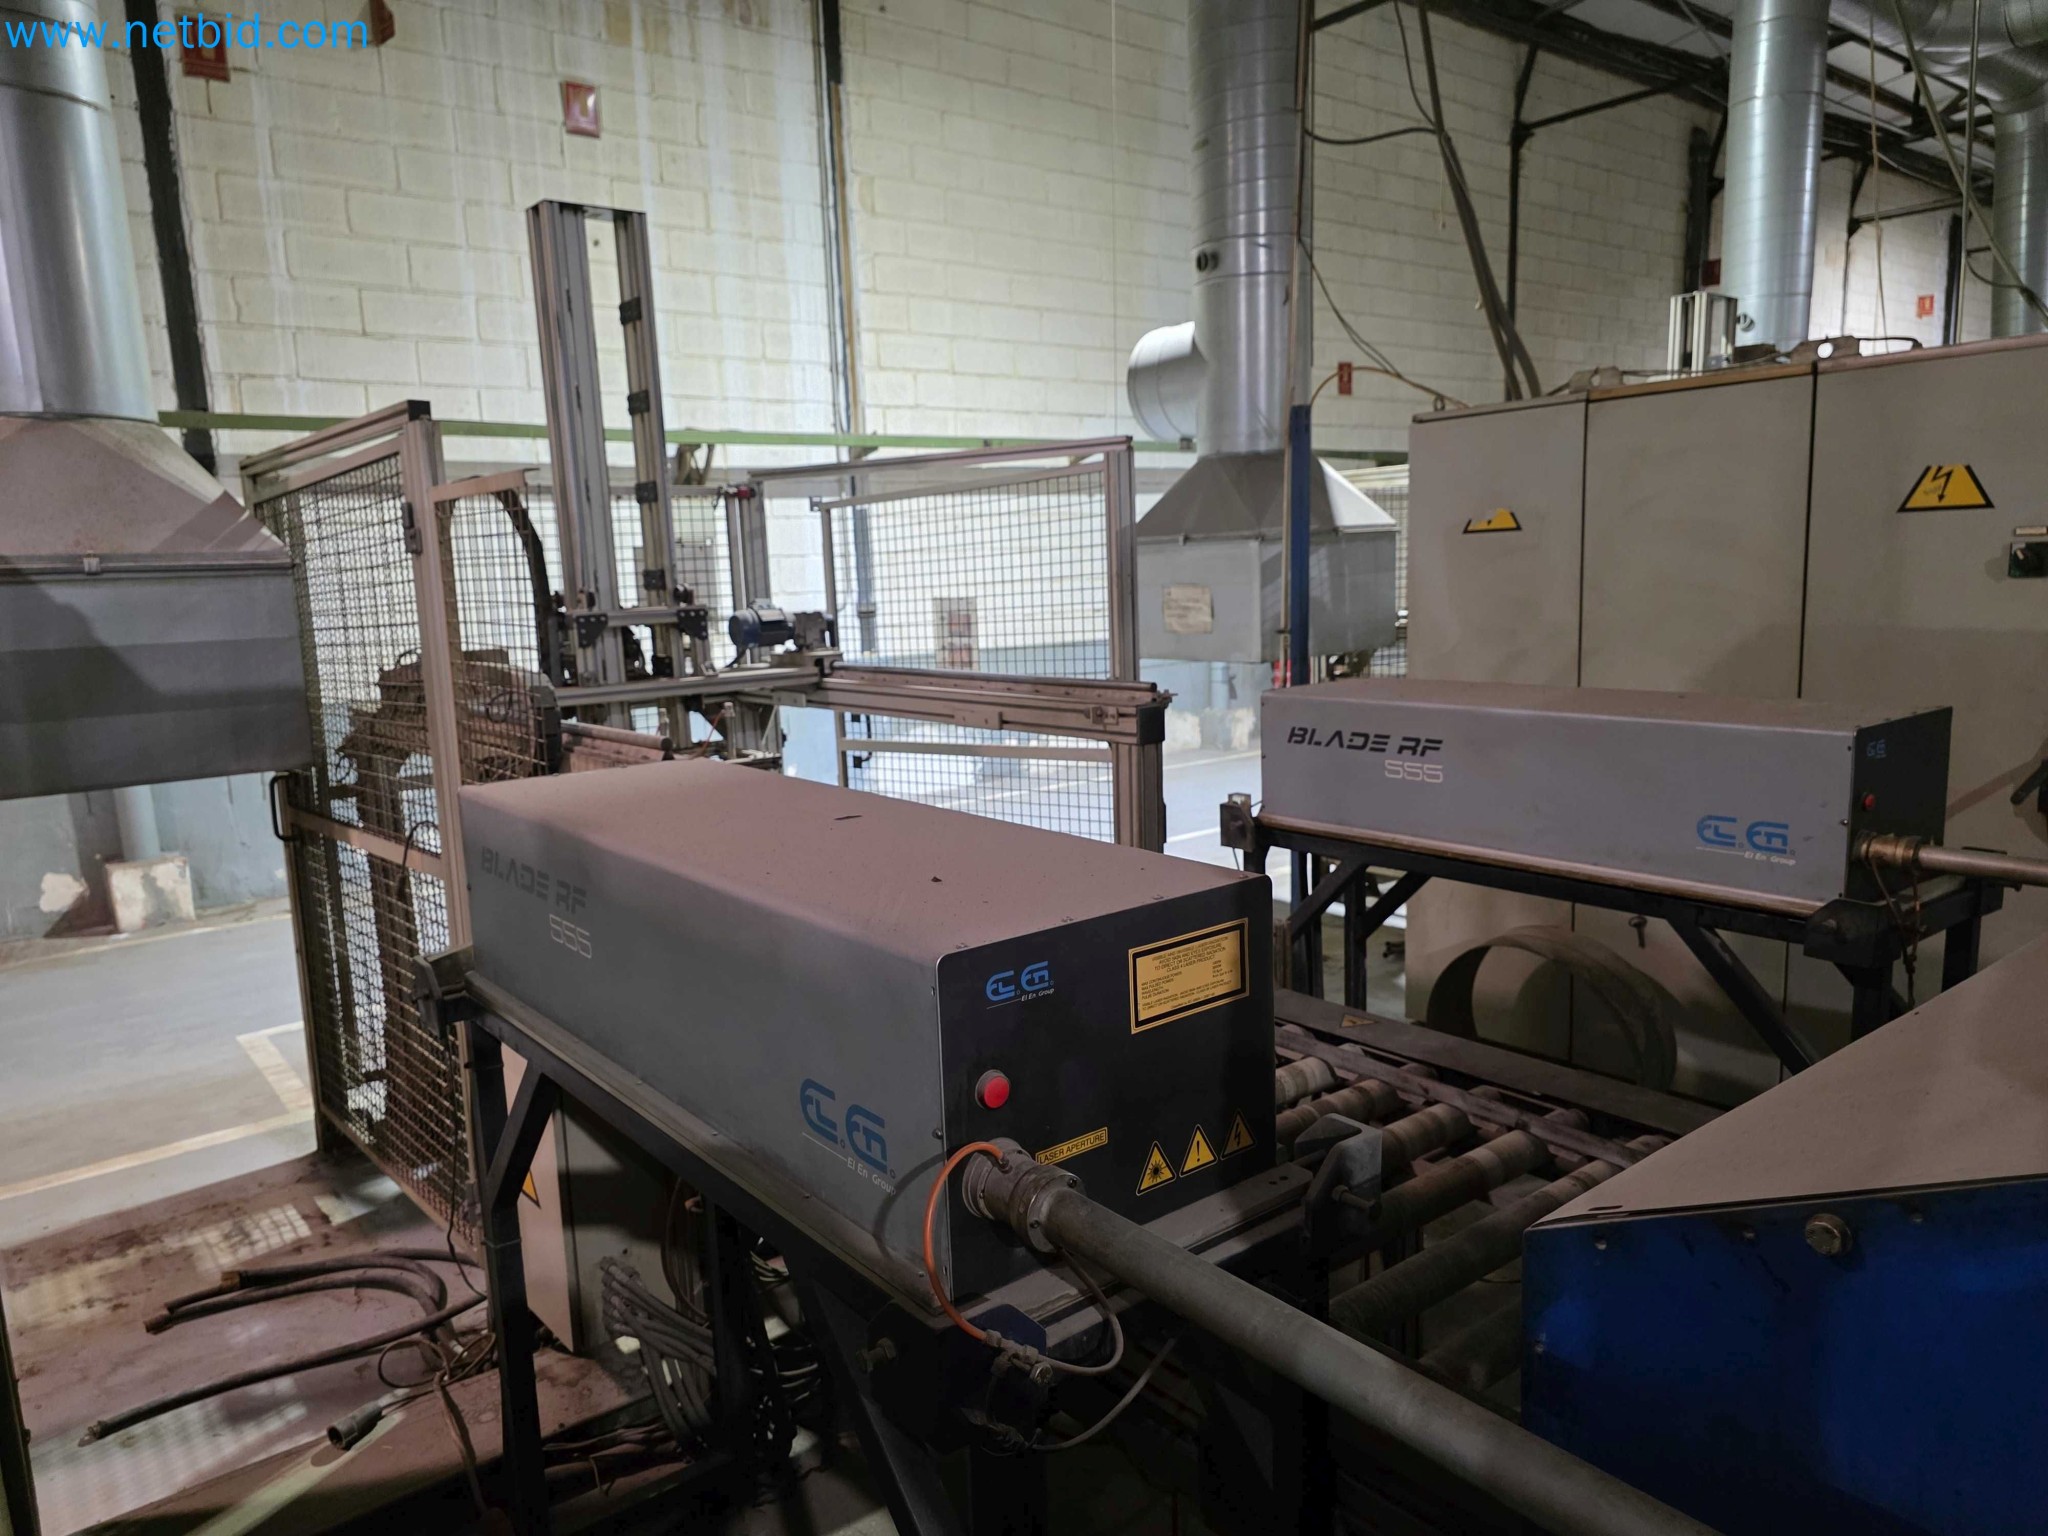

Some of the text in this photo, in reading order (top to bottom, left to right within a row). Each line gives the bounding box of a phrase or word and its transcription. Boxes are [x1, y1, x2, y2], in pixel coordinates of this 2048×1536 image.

[1287, 726, 1444, 757] BLADE RF
[480, 845, 587, 915] BLADE RF
[1038, 988, 1055, 997] Group
[1040, 1132, 1105, 1164] LASER APERTURE
